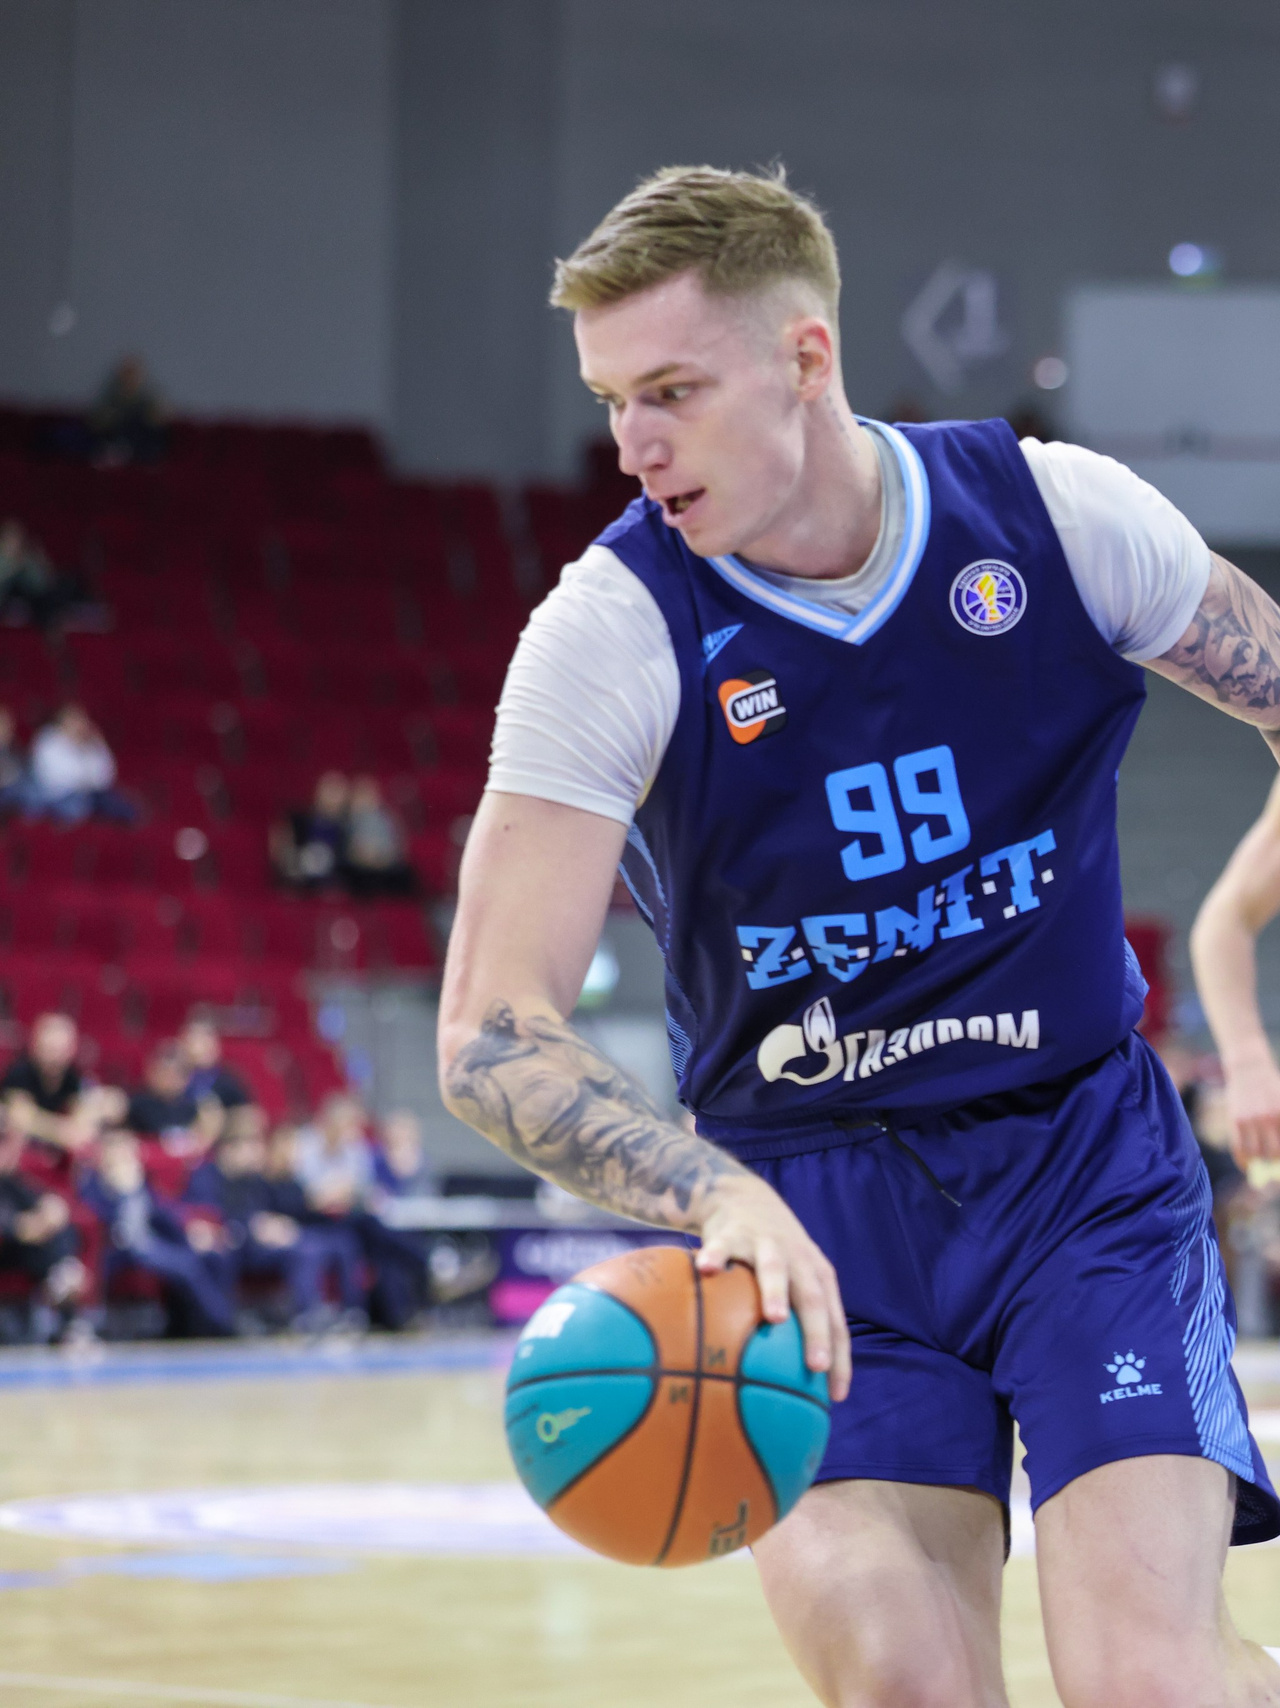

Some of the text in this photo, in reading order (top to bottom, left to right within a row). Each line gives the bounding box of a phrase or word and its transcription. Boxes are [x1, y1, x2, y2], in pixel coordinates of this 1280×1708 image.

[734, 687, 778, 720] WIN
[825, 745, 971, 882] 99
[736, 828, 1057, 990] ZENIT
[1099, 1383, 1163, 1404] KELME
